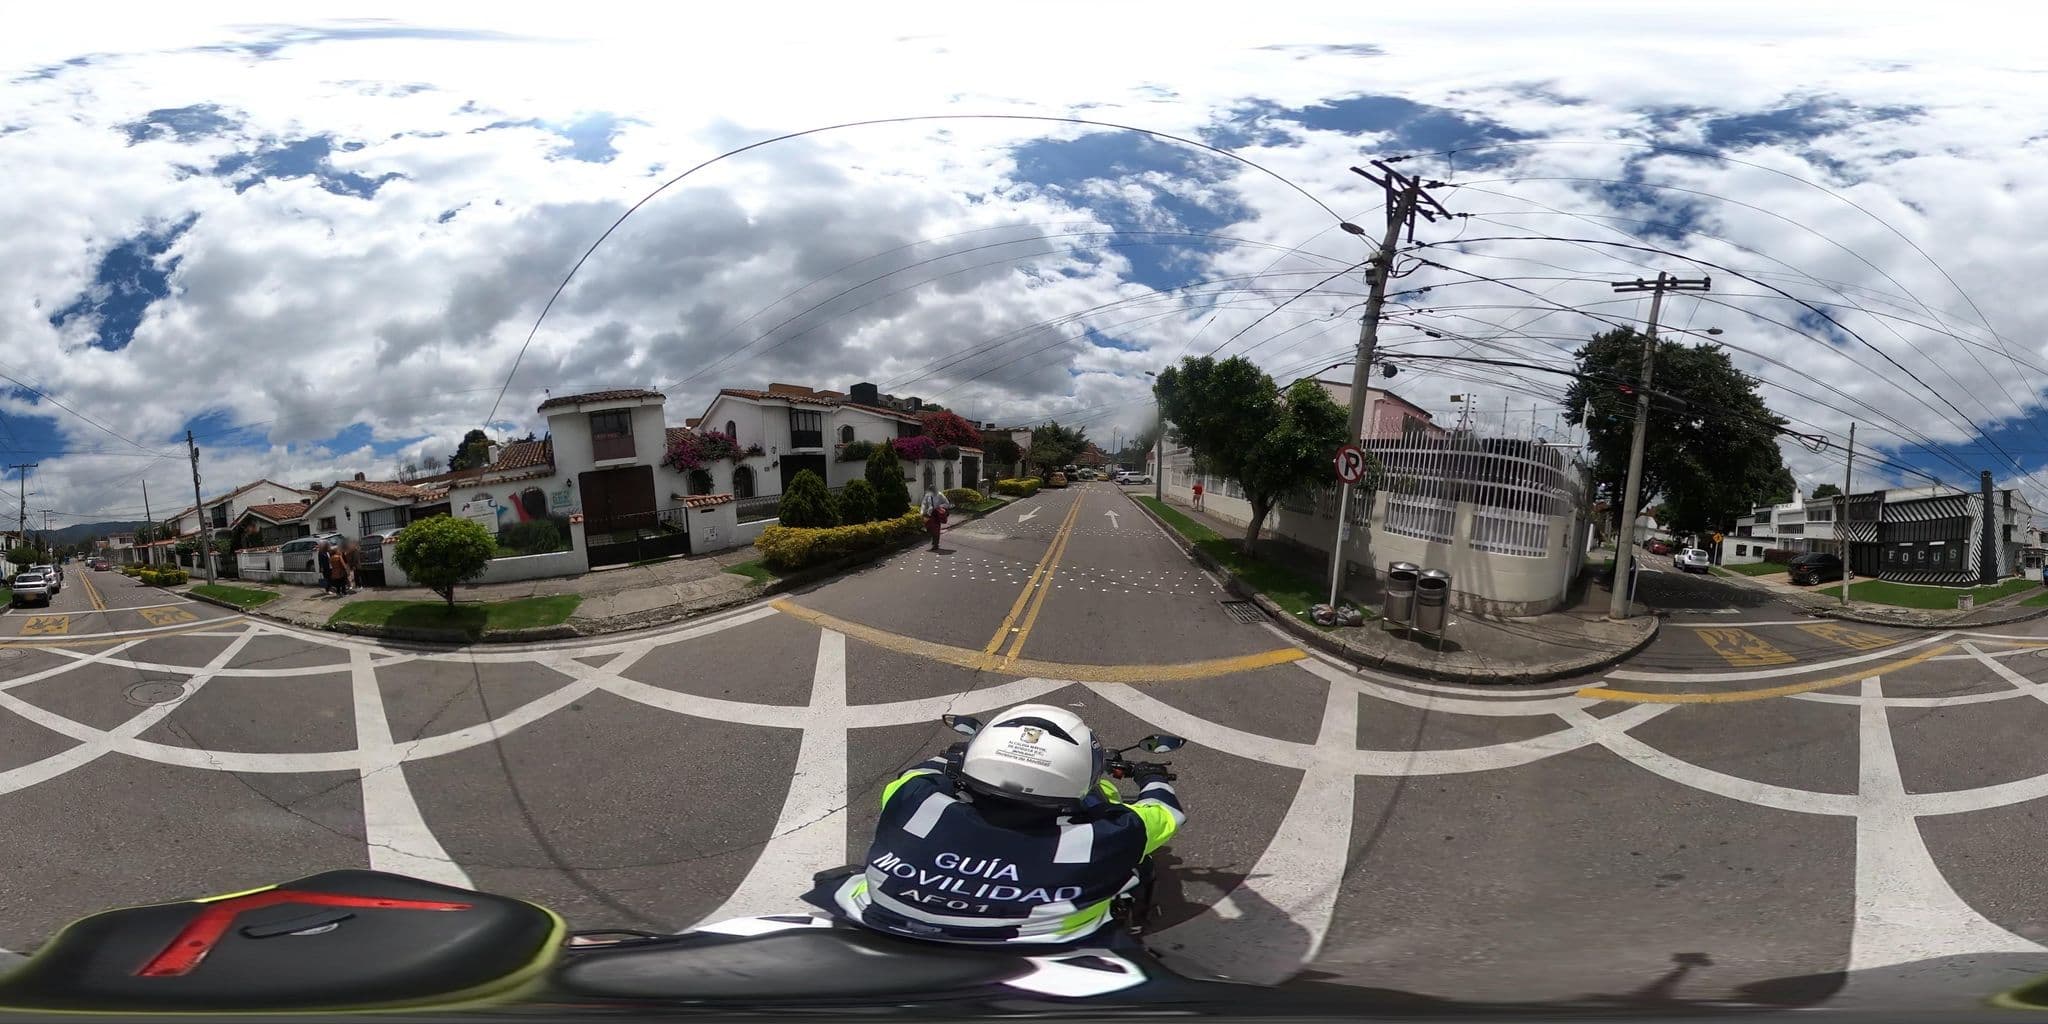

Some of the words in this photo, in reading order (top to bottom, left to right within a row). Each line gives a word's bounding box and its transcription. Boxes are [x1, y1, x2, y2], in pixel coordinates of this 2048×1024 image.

[1889, 549, 1957, 562] FOCUS
[873, 852, 1082, 902] MOVILIDAD
[935, 852, 1019, 881] GUÍA
[899, 889, 990, 913] AF01
